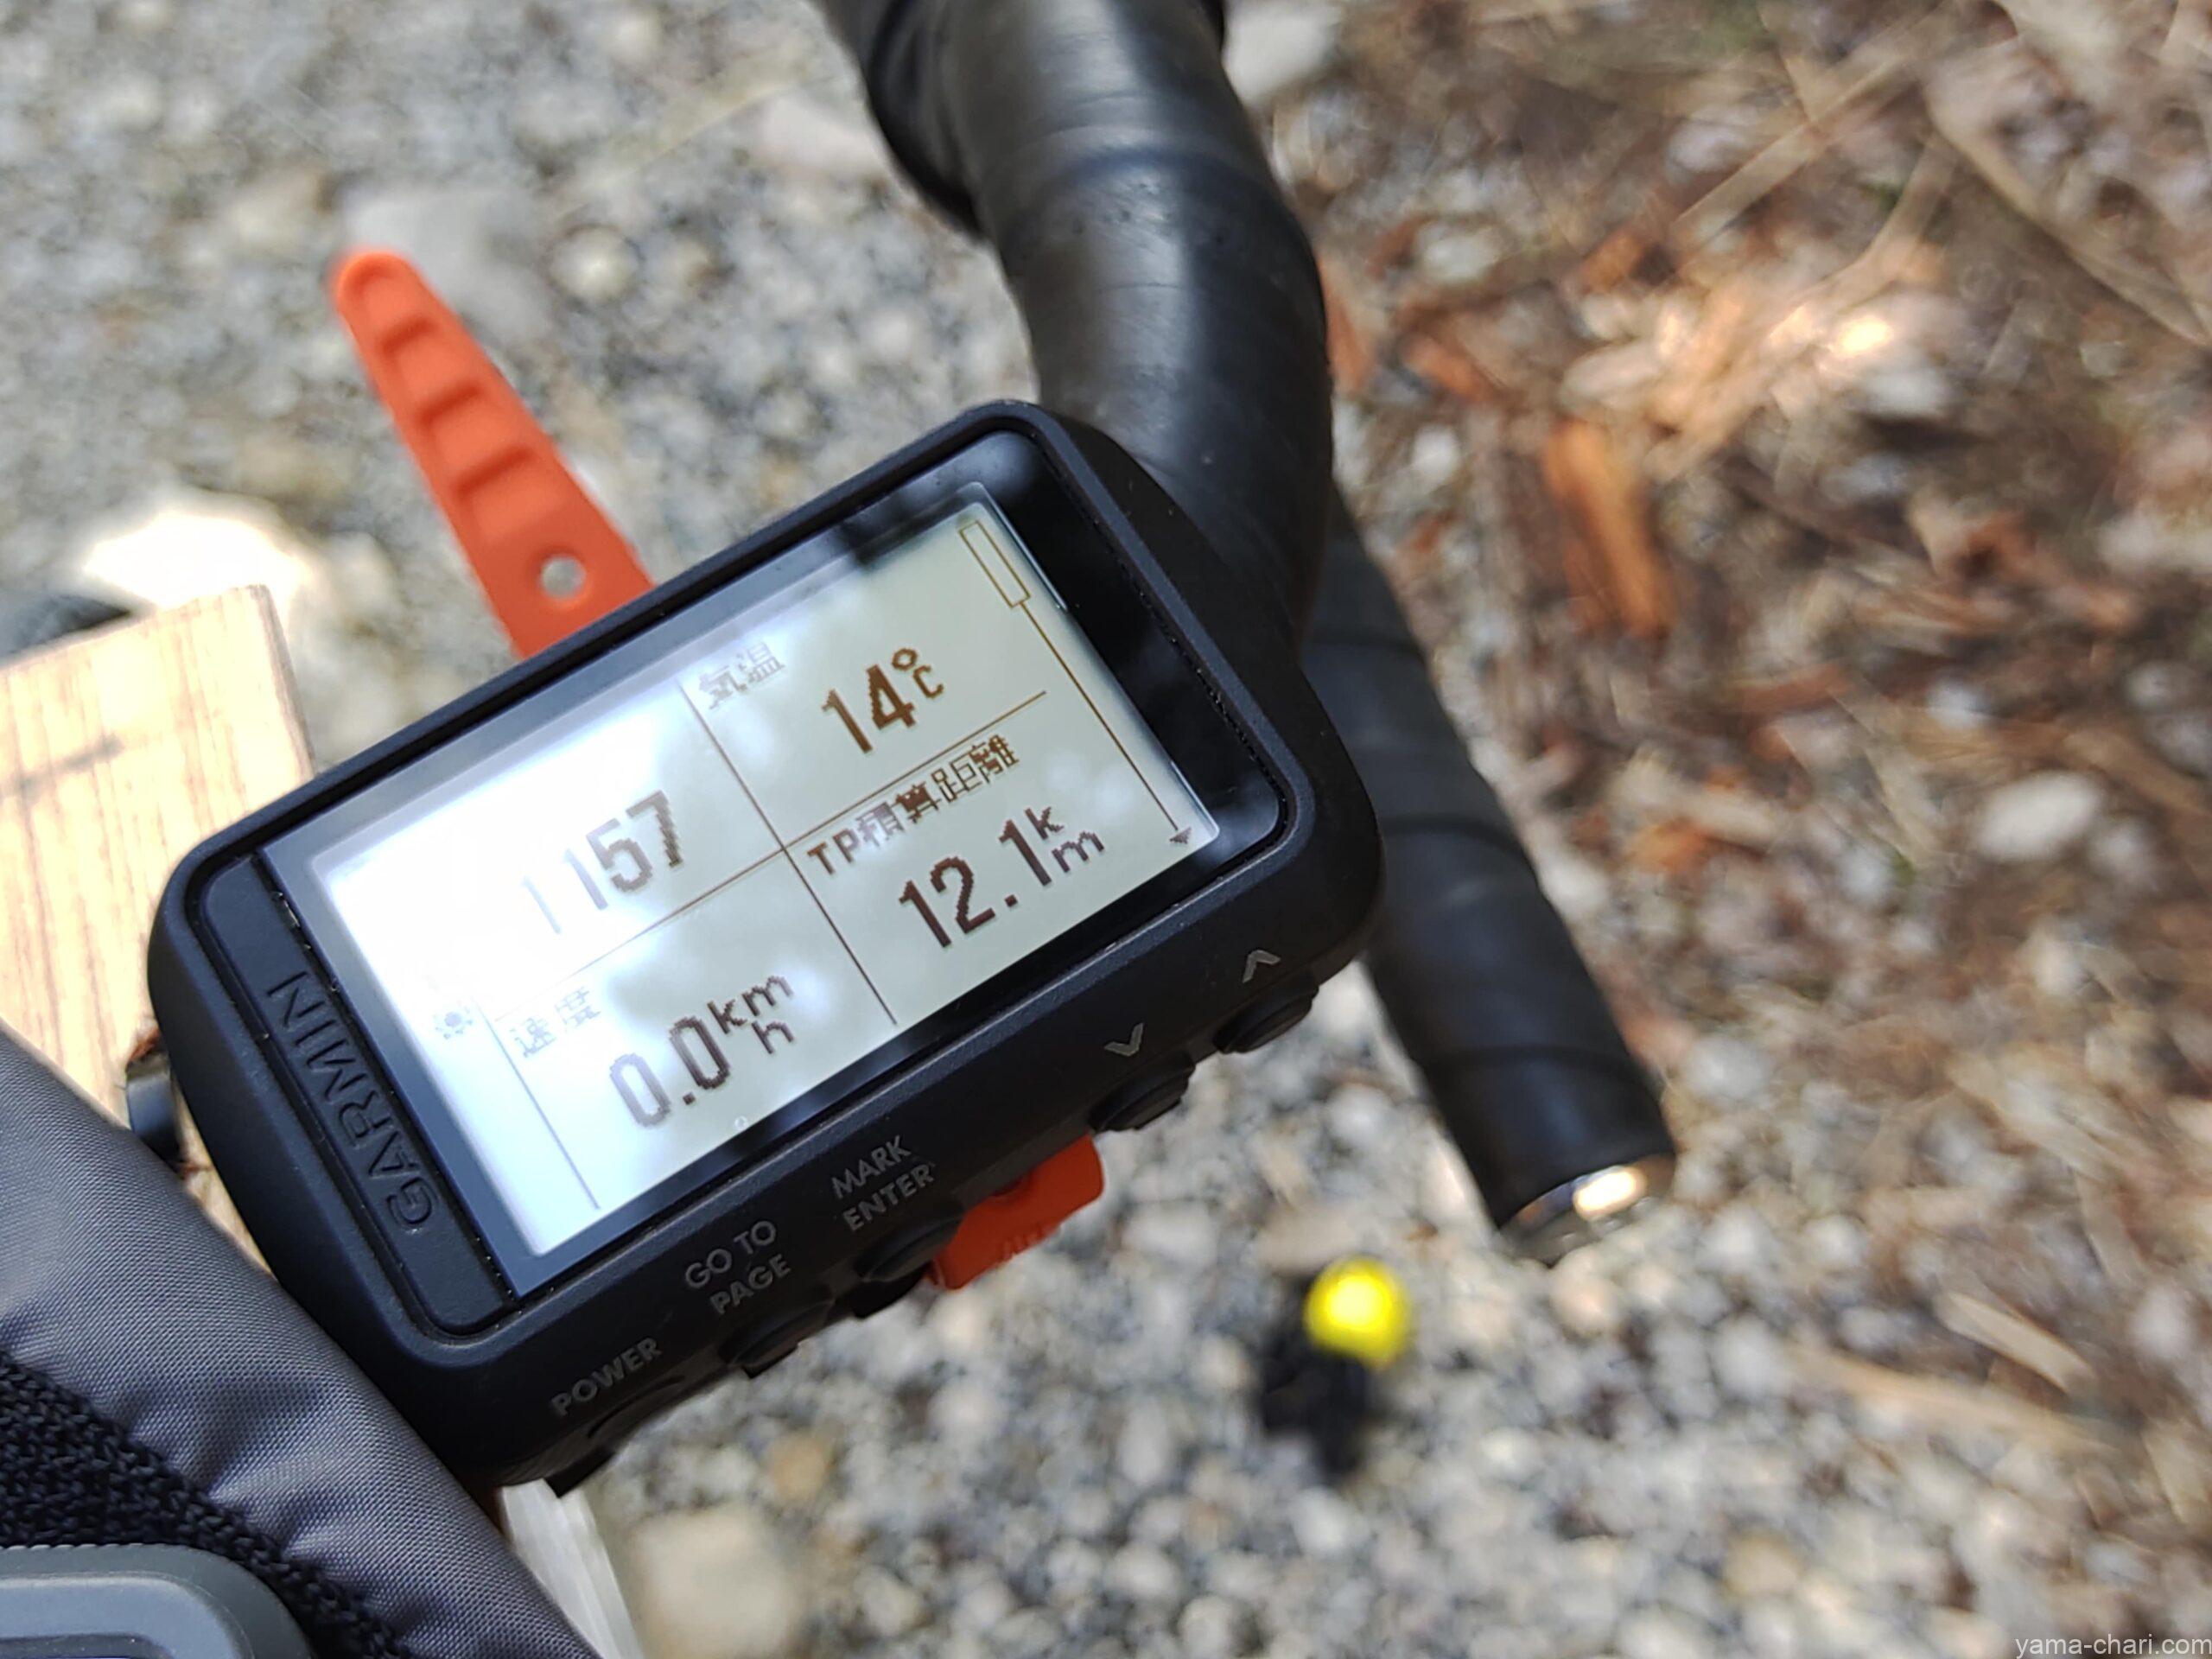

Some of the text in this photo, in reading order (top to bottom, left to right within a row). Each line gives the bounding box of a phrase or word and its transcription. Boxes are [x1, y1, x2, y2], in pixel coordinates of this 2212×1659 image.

[697, 641, 785, 710] 気温
[510, 986, 601, 1058] 速度
[267, 969, 437, 1229] GARMIN
[830, 1135, 912, 1200] MARK
[842, 1163, 936, 1233] ENTER
[684, 1219, 778, 1290] GO TO
[709, 1253, 792, 1316] PAGE
[550, 1336, 664, 1417] POWER
